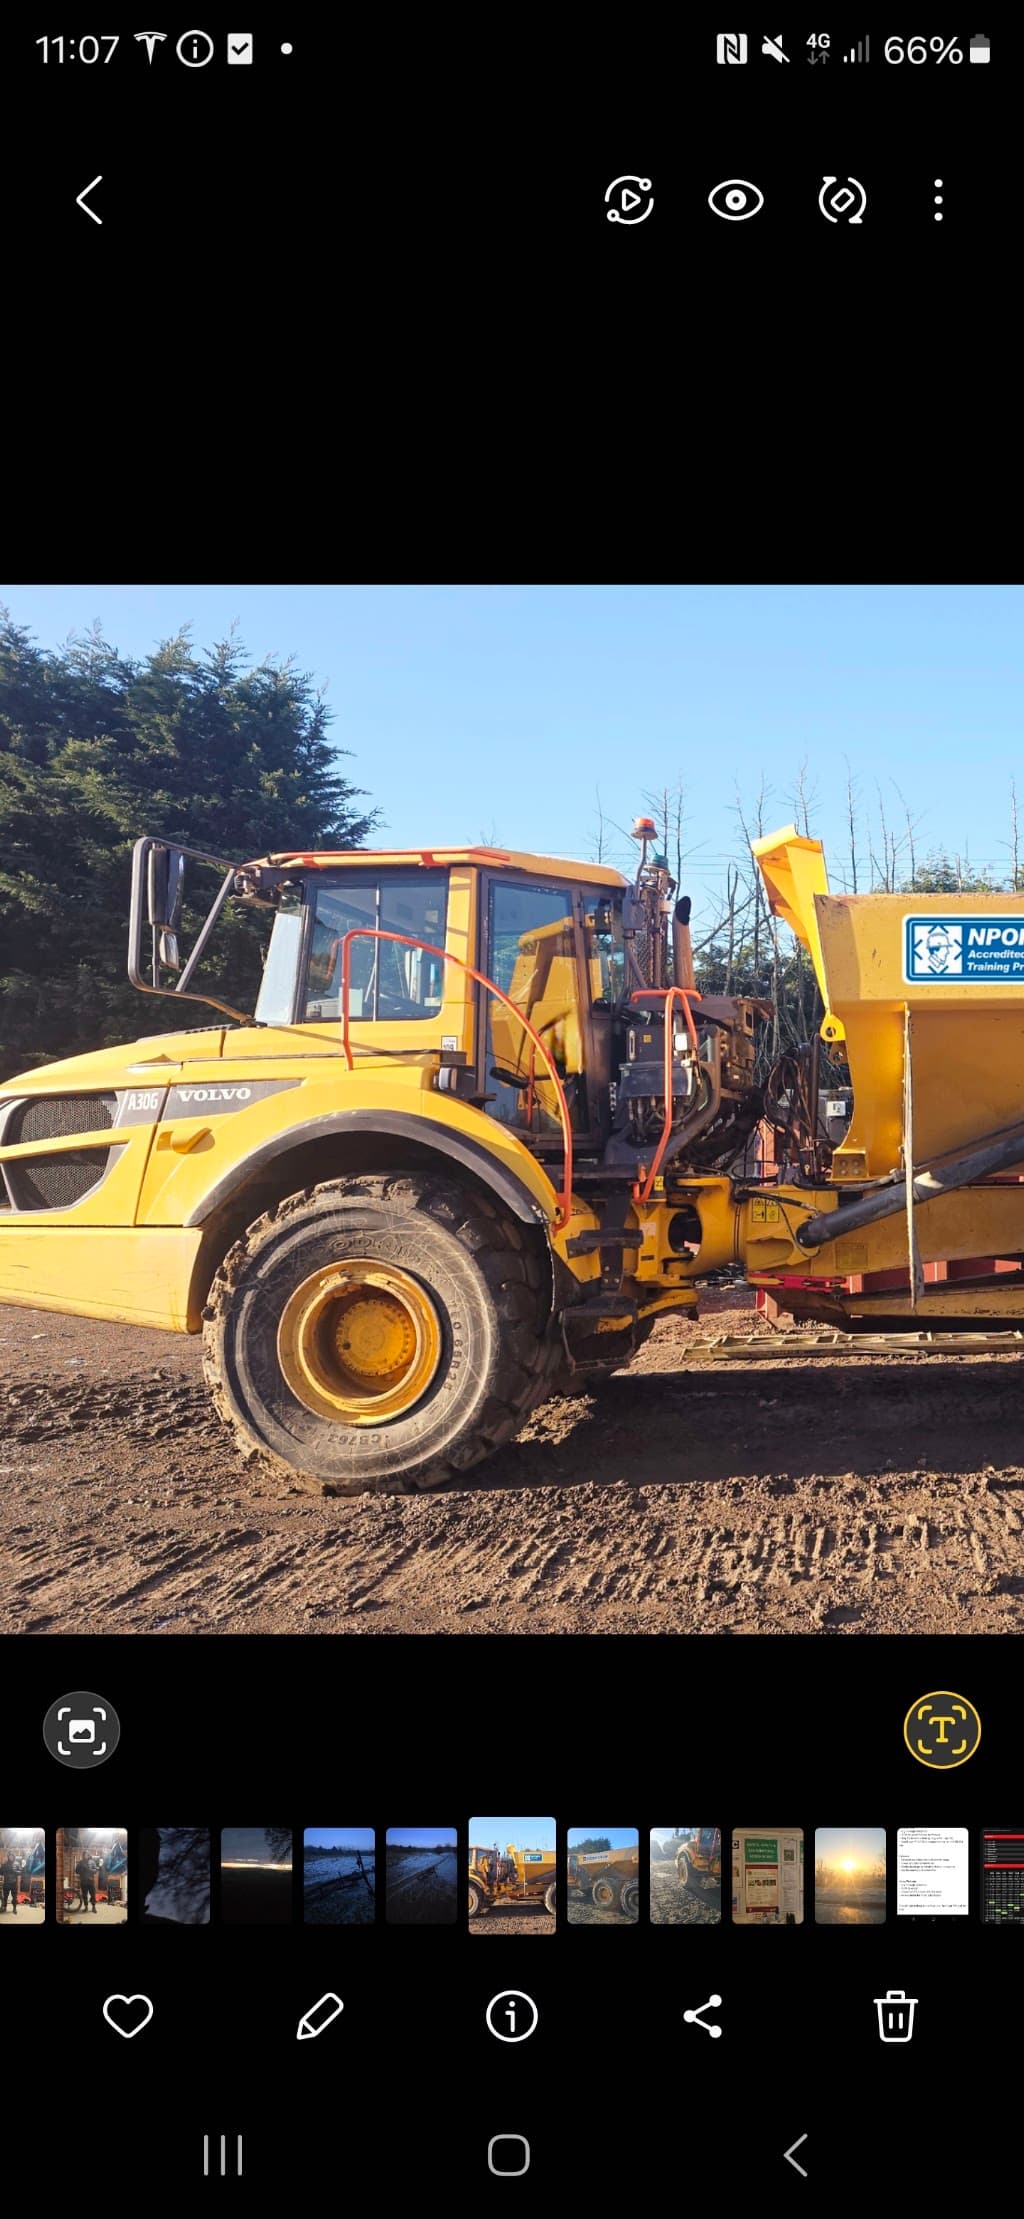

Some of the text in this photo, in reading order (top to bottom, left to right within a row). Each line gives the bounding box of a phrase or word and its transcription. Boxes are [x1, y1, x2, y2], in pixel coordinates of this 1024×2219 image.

[806, 33, 831, 49] 4G
[35, 35, 120, 64] 11:07
[884, 36, 964, 65] 66%
[966, 961, 1010, 973] Training
[177, 1087, 252, 1102] VOLVO
